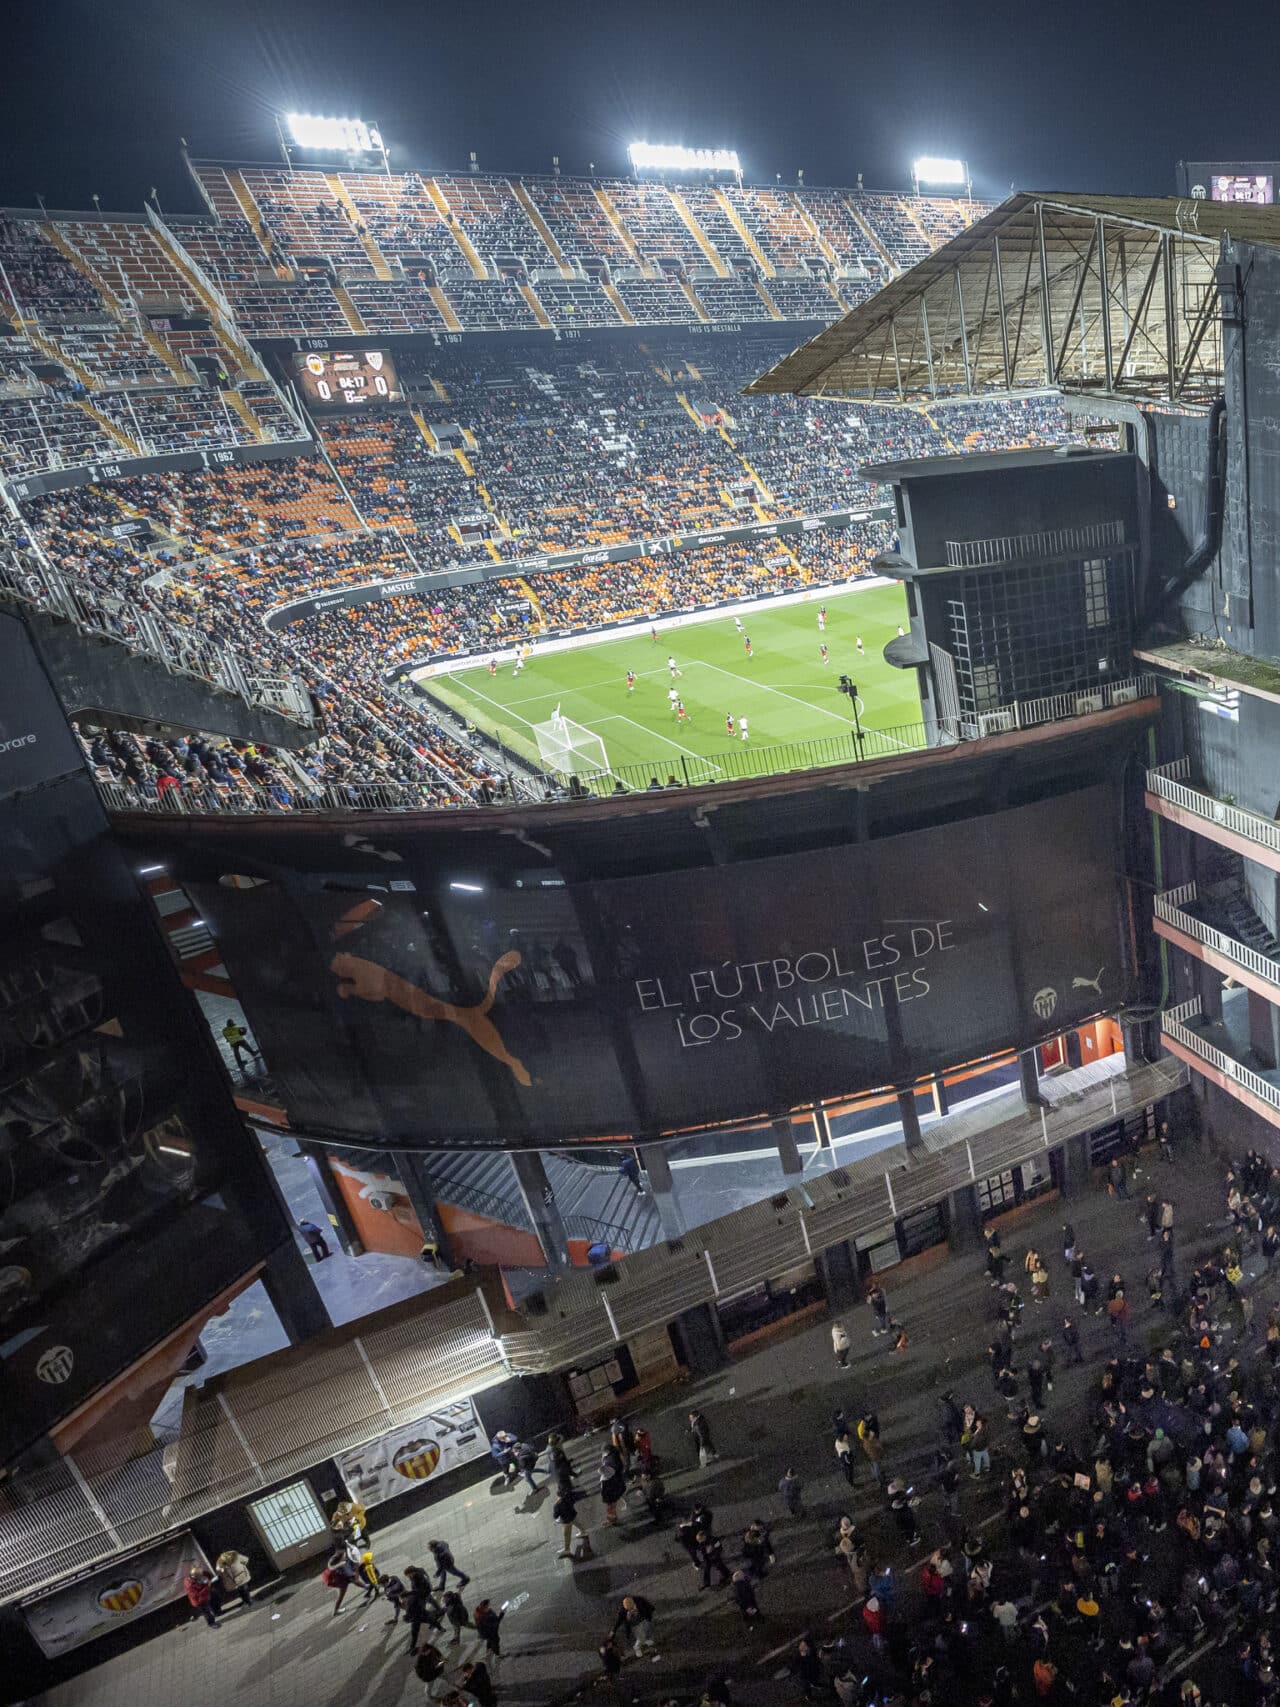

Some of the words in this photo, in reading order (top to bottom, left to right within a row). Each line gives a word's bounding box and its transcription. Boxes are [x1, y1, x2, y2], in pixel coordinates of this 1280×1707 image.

[565, 330, 580, 338] 1971
[688, 325, 702, 333] THIS
[704, 325, 711, 333] IS
[712, 324, 741, 332] MESTALLA
[307, 339, 329, 348] 1963
[444, 334, 462, 343] 1967
[317, 380, 331, 400] 0
[375, 376, 388, 396] 0
[213, 451, 235, 462] 1962
[101, 465, 121, 478] 1954
[459, 514, 488, 523] CAZOO
[381, 581, 417, 594] AMSTEL
[635, 978, 683, 1011] EL
[689, 947, 855, 1003] FÚTBOL
[863, 934, 901, 970] ES
[911, 920, 956, 957] DE
[676, 1009, 743, 1048] LOS
[750, 967, 931, 1032] VALIENTES
